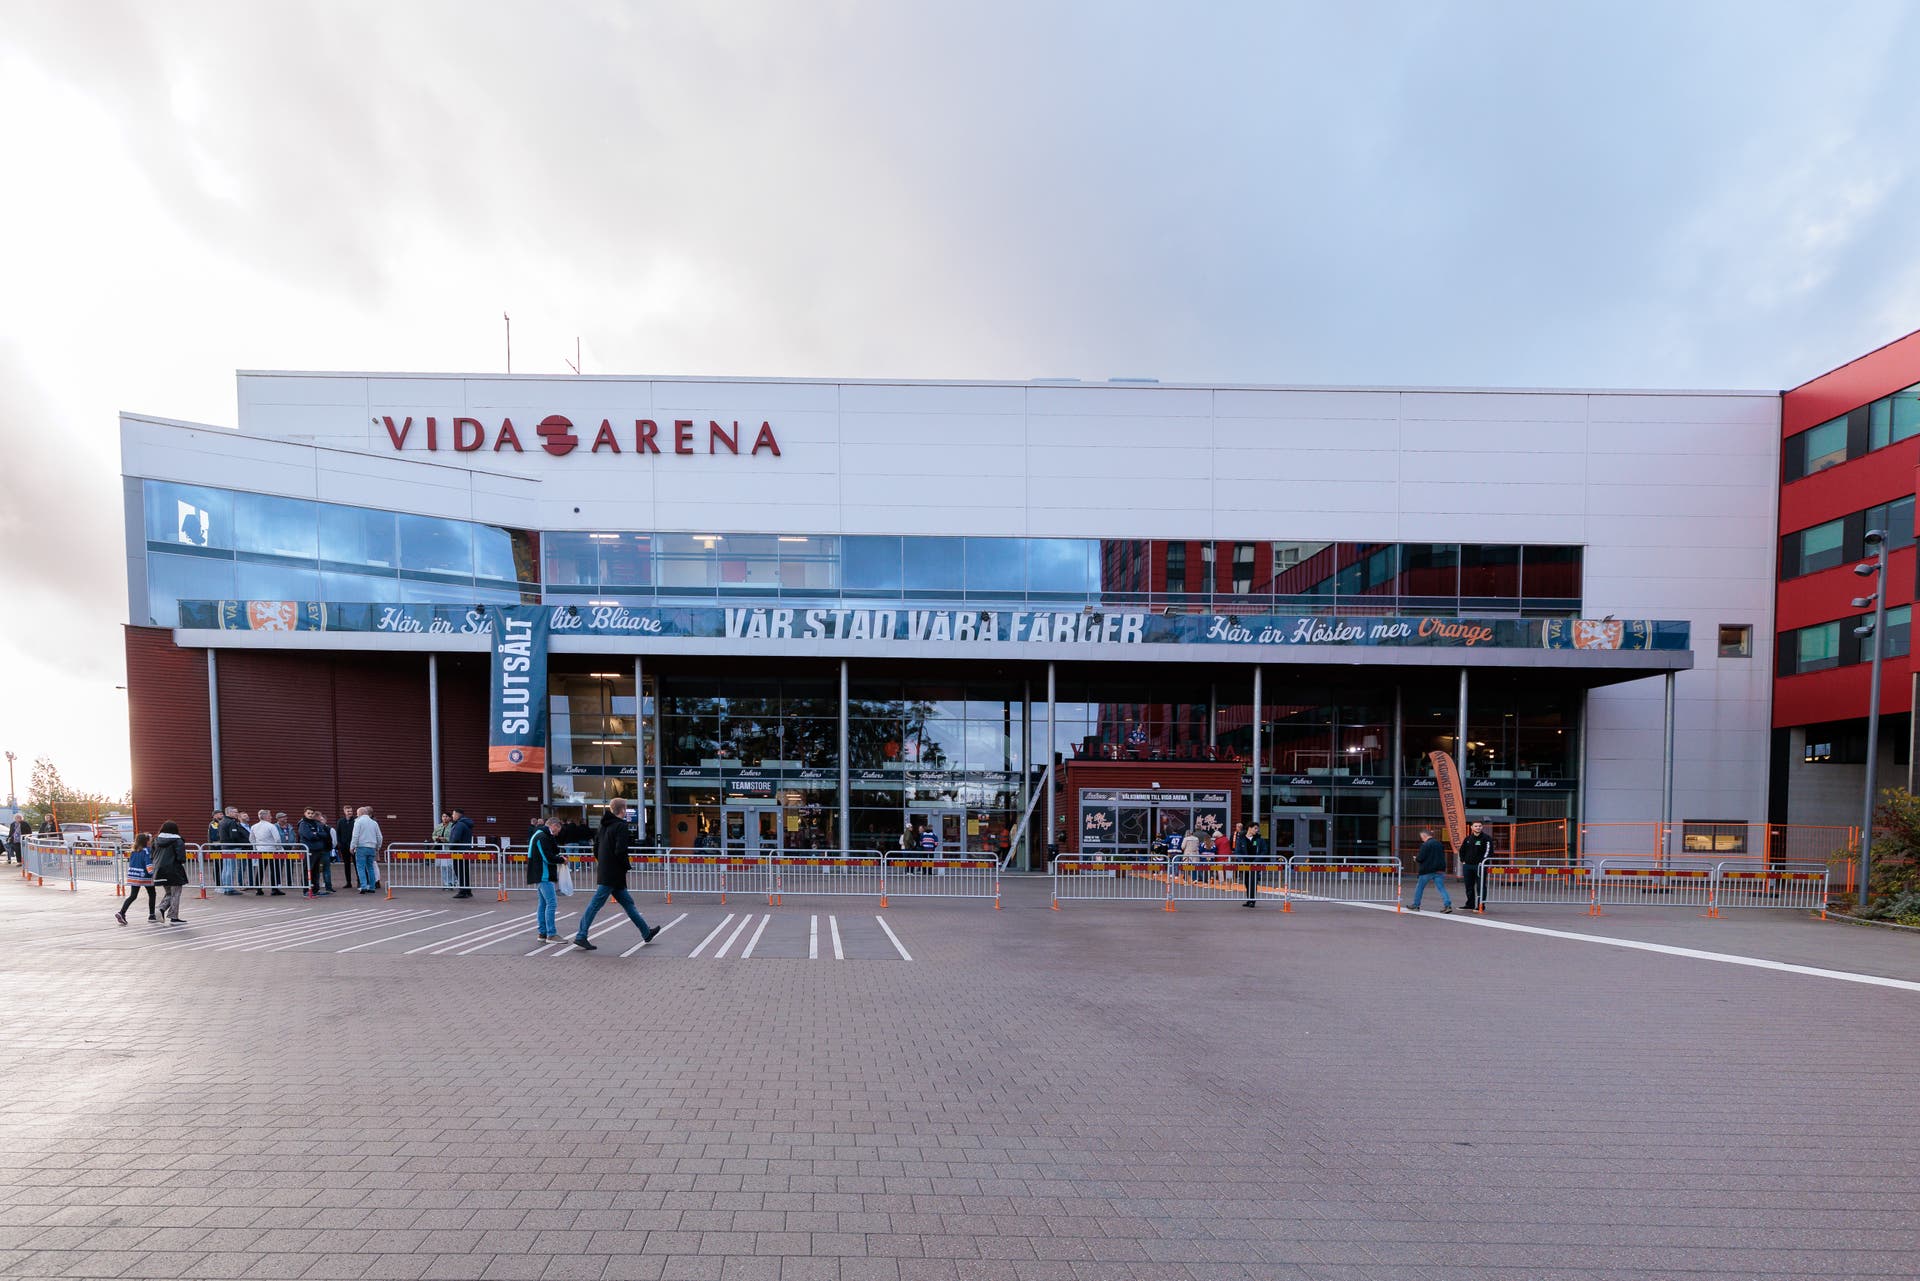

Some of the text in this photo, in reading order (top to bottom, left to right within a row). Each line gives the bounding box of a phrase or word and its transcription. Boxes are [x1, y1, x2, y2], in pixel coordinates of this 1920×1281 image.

[382, 416, 781, 456] VIDA ARENA
[376, 607, 423, 633] Här
[429, 616, 454, 633] är
[588, 606, 662, 633] Blåare
[724, 608, 794, 640] VÅR
[802, 608, 897, 641] STAD
[1010, 611, 1145, 644] FÄRGER
[1206, 615, 1493, 646] Här är Hösten mer Orange
[498, 617, 533, 735] SLUTSÅLT
[564, 766, 588, 774] Lakers
[678, 768, 701, 776] Lakers
[738, 769, 762, 777] Lakers
[799, 770, 822, 778] Lakers
[861, 771, 884, 779] Lakers
[1290, 777, 1313, 785] Lakers
[1351, 778, 1375, 786] Lakers
[1412, 778, 1435, 787] Lakers
[1473, 779, 1496, 788] Lakers
[1534, 780, 1557, 788] Lakers
[731, 781, 772, 791] TEAMSTORE
